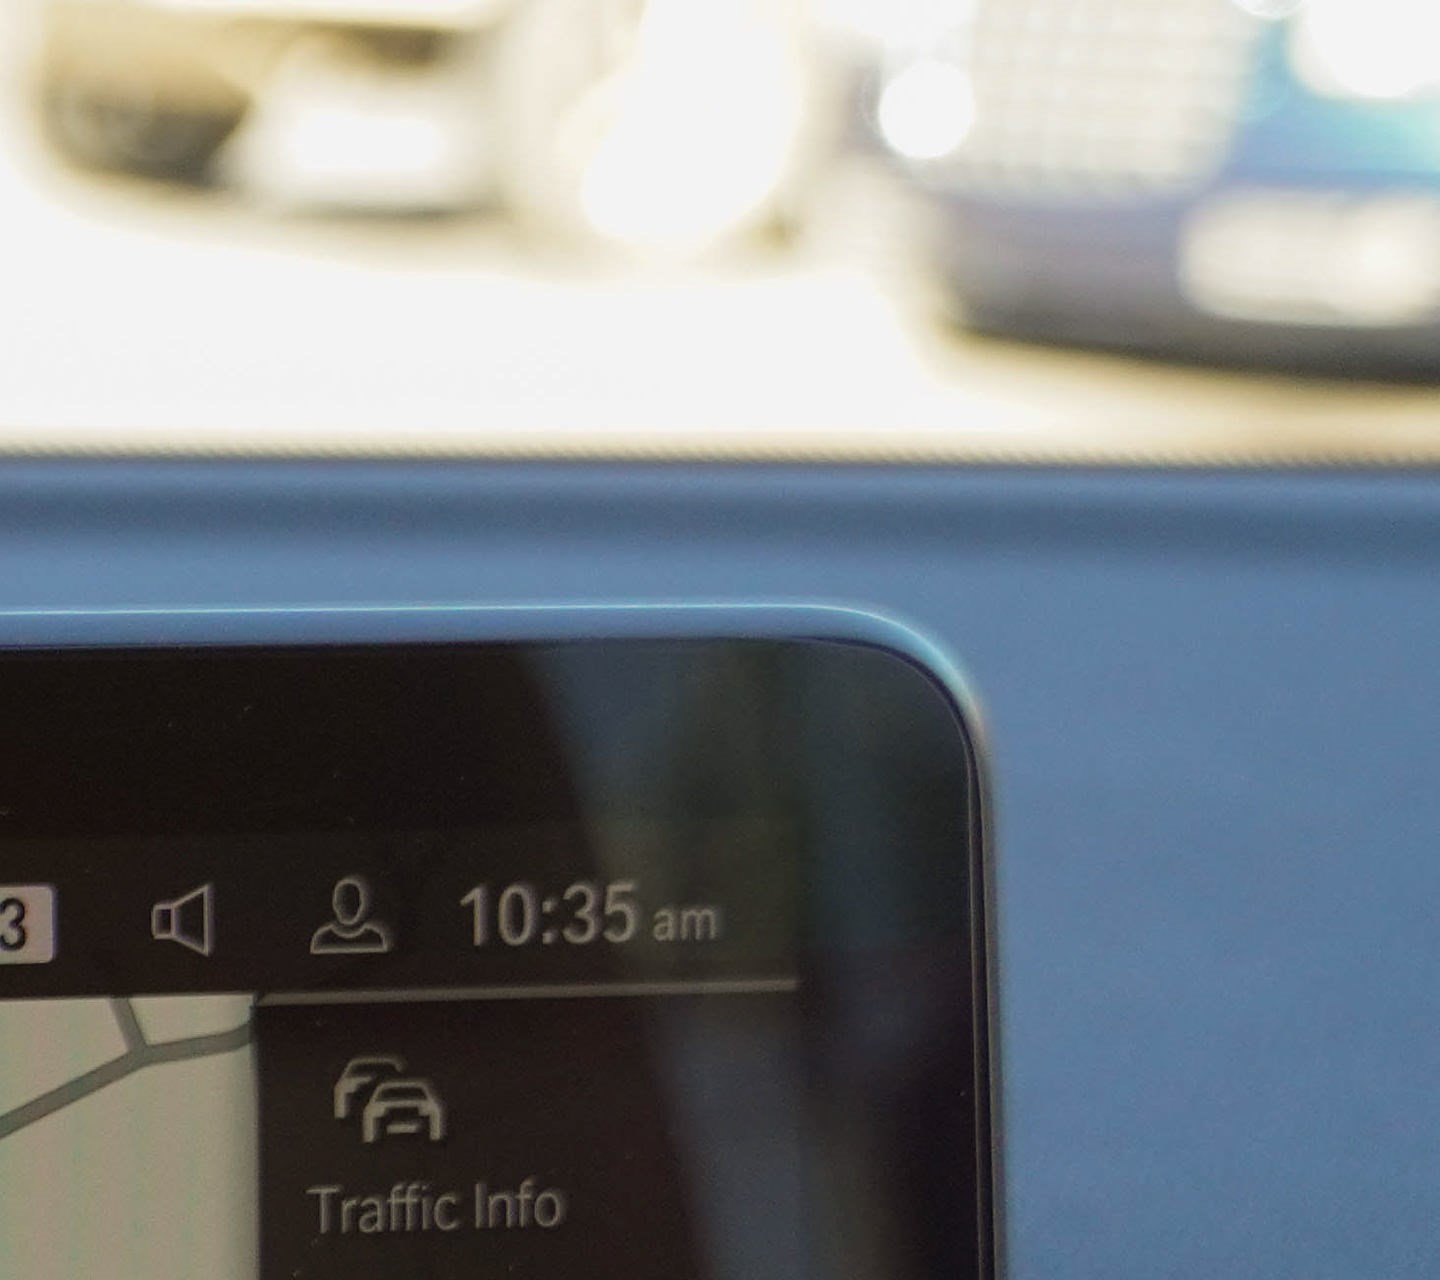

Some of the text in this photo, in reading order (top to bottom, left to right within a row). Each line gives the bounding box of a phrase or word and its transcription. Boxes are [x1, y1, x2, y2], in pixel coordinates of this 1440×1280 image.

[459, 883, 719, 947] 10:35 am
[307, 1178, 566, 1235] Traffic Info
